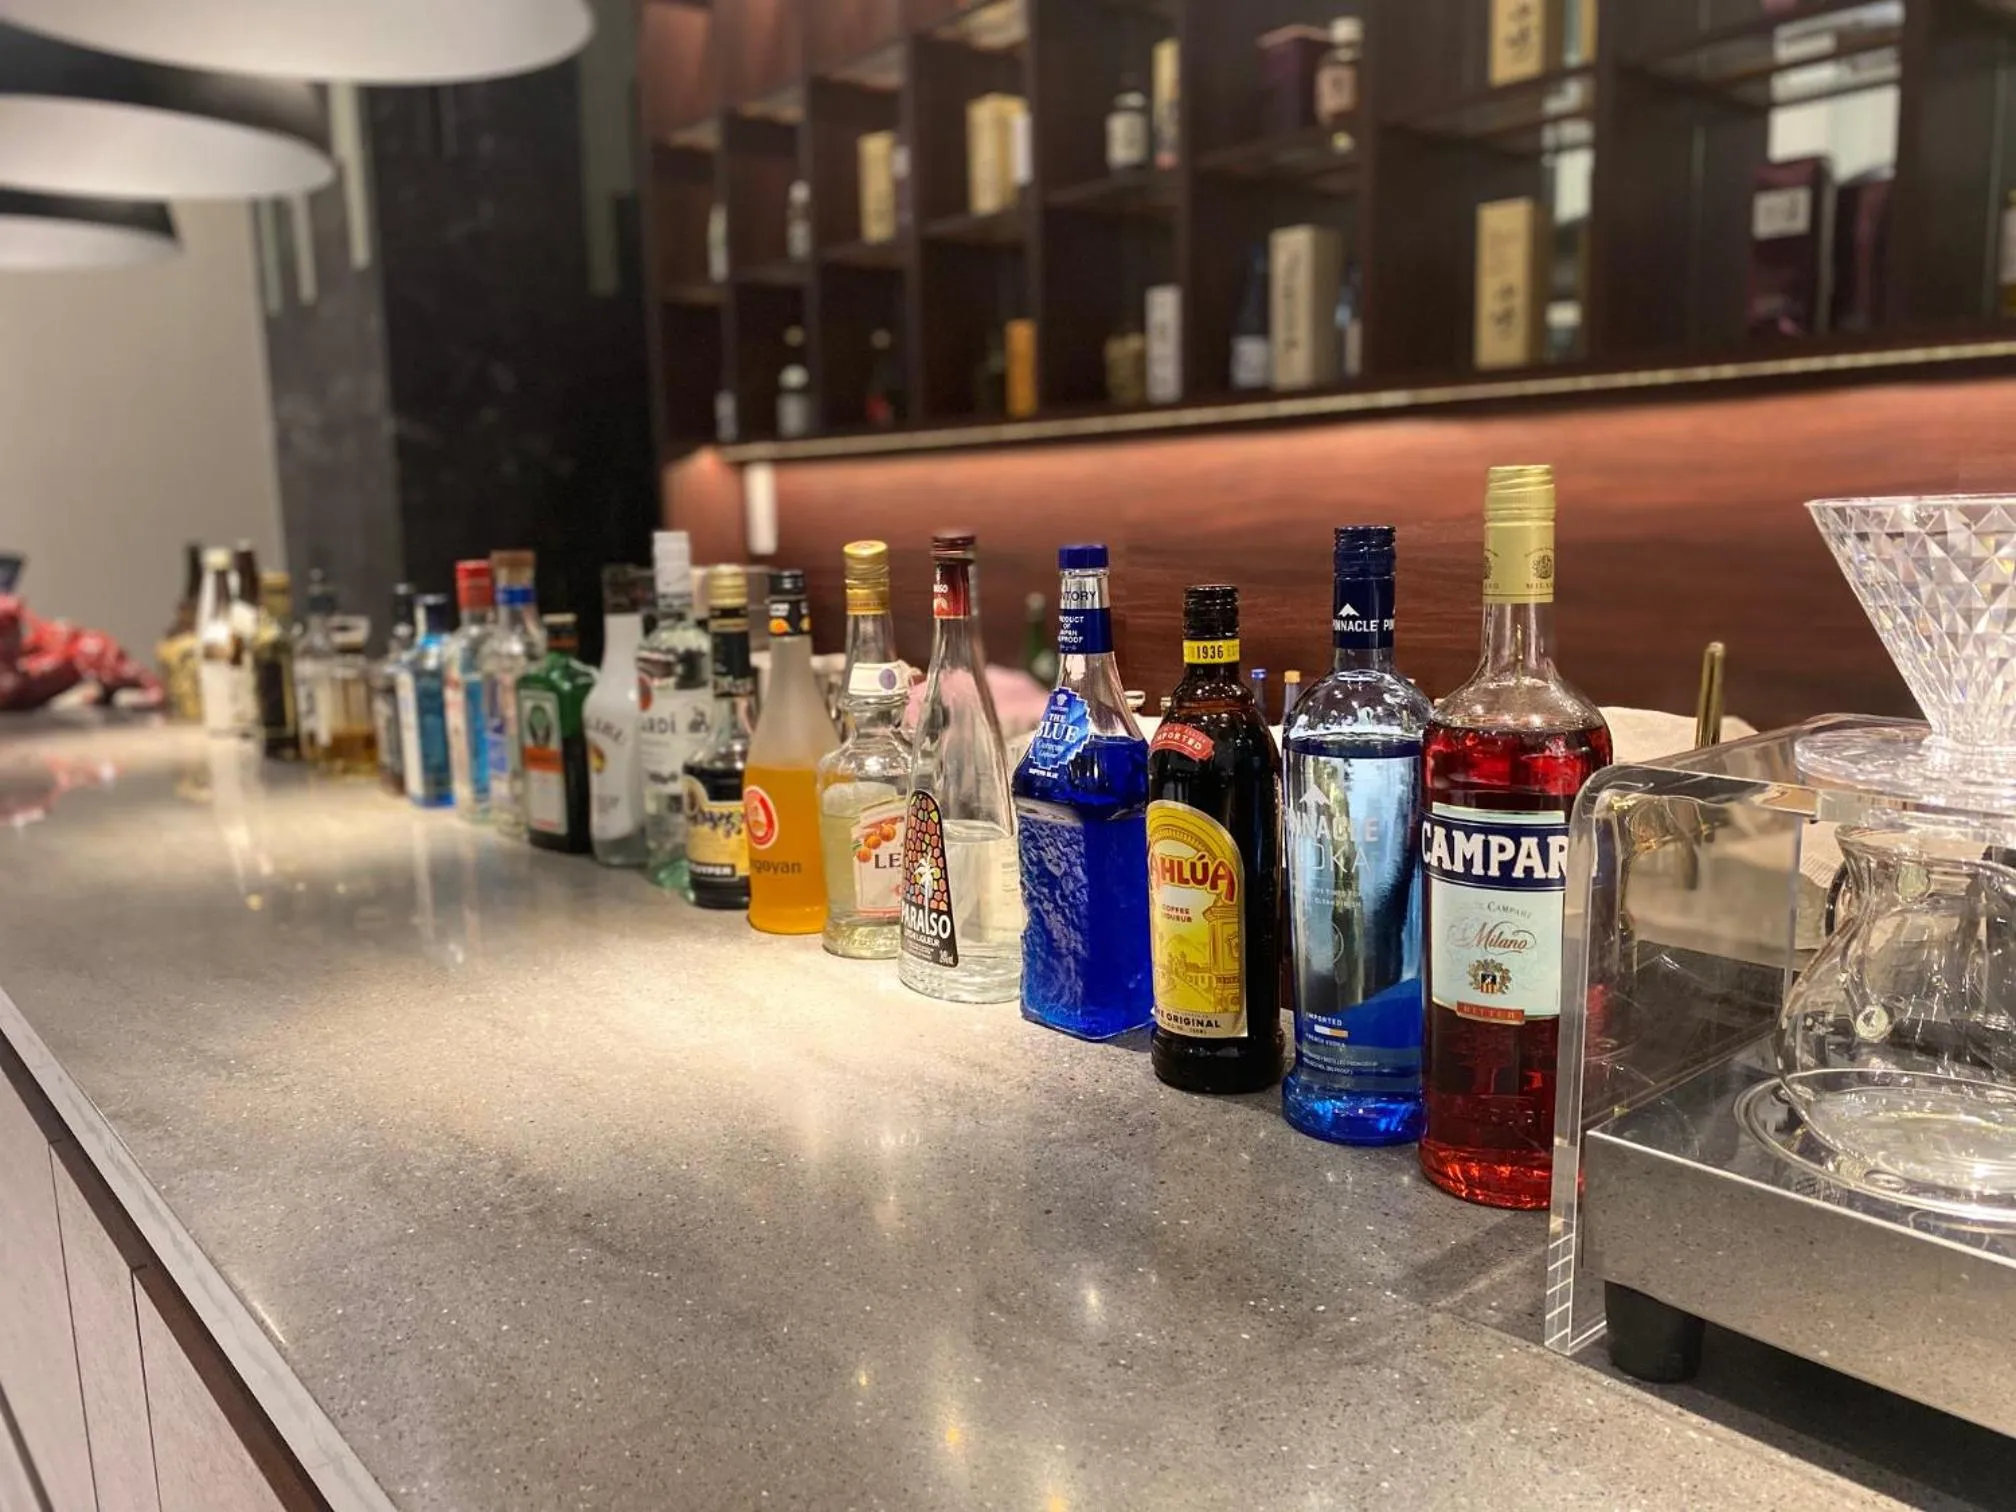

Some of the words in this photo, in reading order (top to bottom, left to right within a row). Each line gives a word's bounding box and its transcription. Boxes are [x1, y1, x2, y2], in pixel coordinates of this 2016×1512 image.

[1197, 645, 1224, 660] 1936
[1472, 921, 1530, 951] Milano
[1166, 1012, 1221, 1028] ORIGINAL
